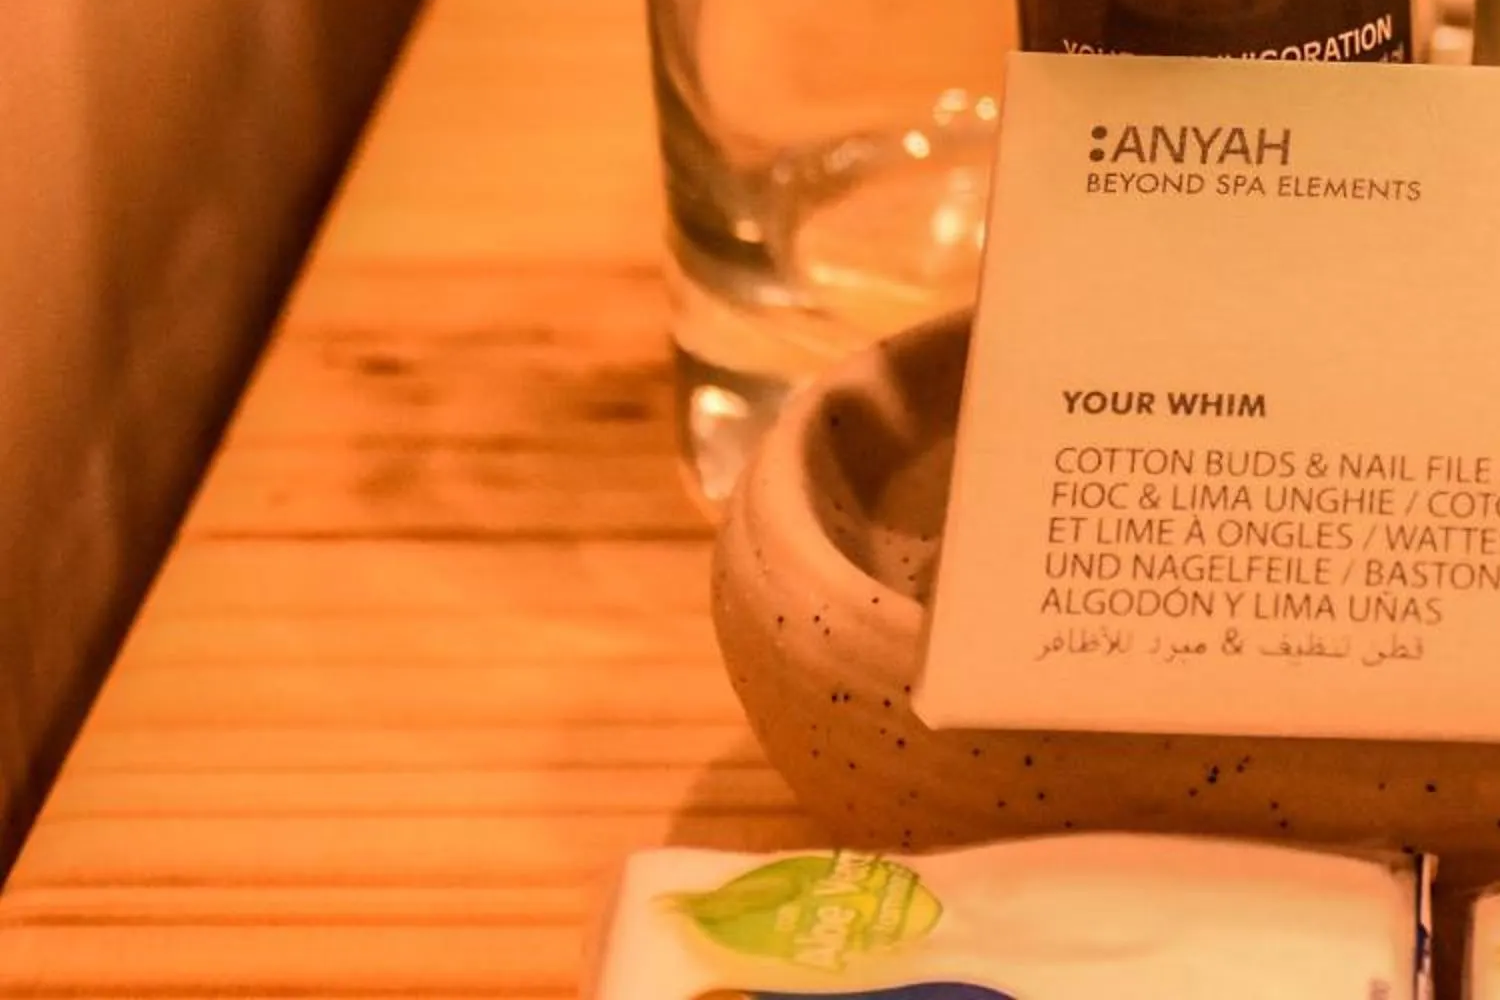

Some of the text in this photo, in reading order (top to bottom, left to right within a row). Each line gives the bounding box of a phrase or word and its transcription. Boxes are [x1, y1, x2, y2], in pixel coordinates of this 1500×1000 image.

[1086, 172, 1422, 202] BEYOND SPA ELEMENTS
[1062, 390, 1267, 418] YOUR WHIM
[1055, 446, 1194, 475] COTTON
[1205, 449, 1296, 478] BUDS
[1304, 452, 1329, 479] &
[1338, 452, 1415, 483] NAIL
[1426, 455, 1493, 484] FILE
[1051, 480, 1130, 509] FIOC
[1138, 482, 1162, 511] &
[1171, 484, 1253, 513] LIMA
[1264, 486, 1395, 516] UNGHIE
[1404, 490, 1420, 516] /
[1047, 516, 1089, 544] ET
[1096, 517, 1175, 545] LIME
[1184, 513, 1207, 547] À
[1216, 518, 1354, 550] ONGLES
[1361, 523, 1378, 550] /
[1044, 551, 1122, 581] UND
[1131, 552, 1333, 585] NAGELFEILE
[1340, 557, 1357, 585] /
[1040, 585, 1444, 626] ALGODÓN Y LIMA UÑAS
[1220, 626, 1244, 656] &
